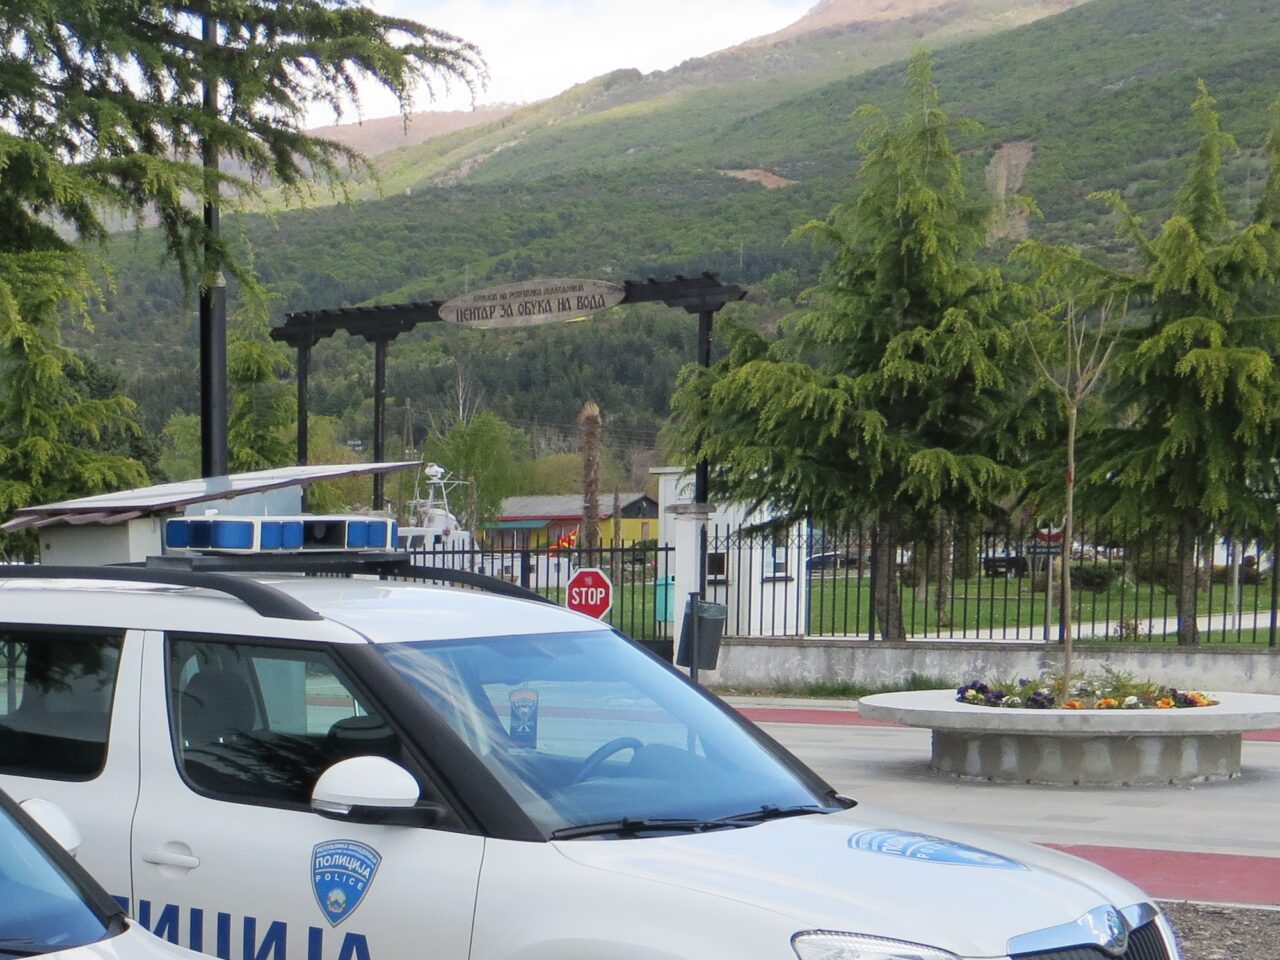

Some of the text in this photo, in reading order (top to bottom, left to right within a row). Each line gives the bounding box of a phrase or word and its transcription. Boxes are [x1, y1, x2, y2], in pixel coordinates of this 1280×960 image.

[456, 294, 606, 322] ЦЕНТАР ЗА ОБУКА НА ВОДА
[571, 587, 606, 605] STOP
[316, 855, 371, 879] ПОЛИЦИЈА
[316, 873, 364, 891] POLICE
